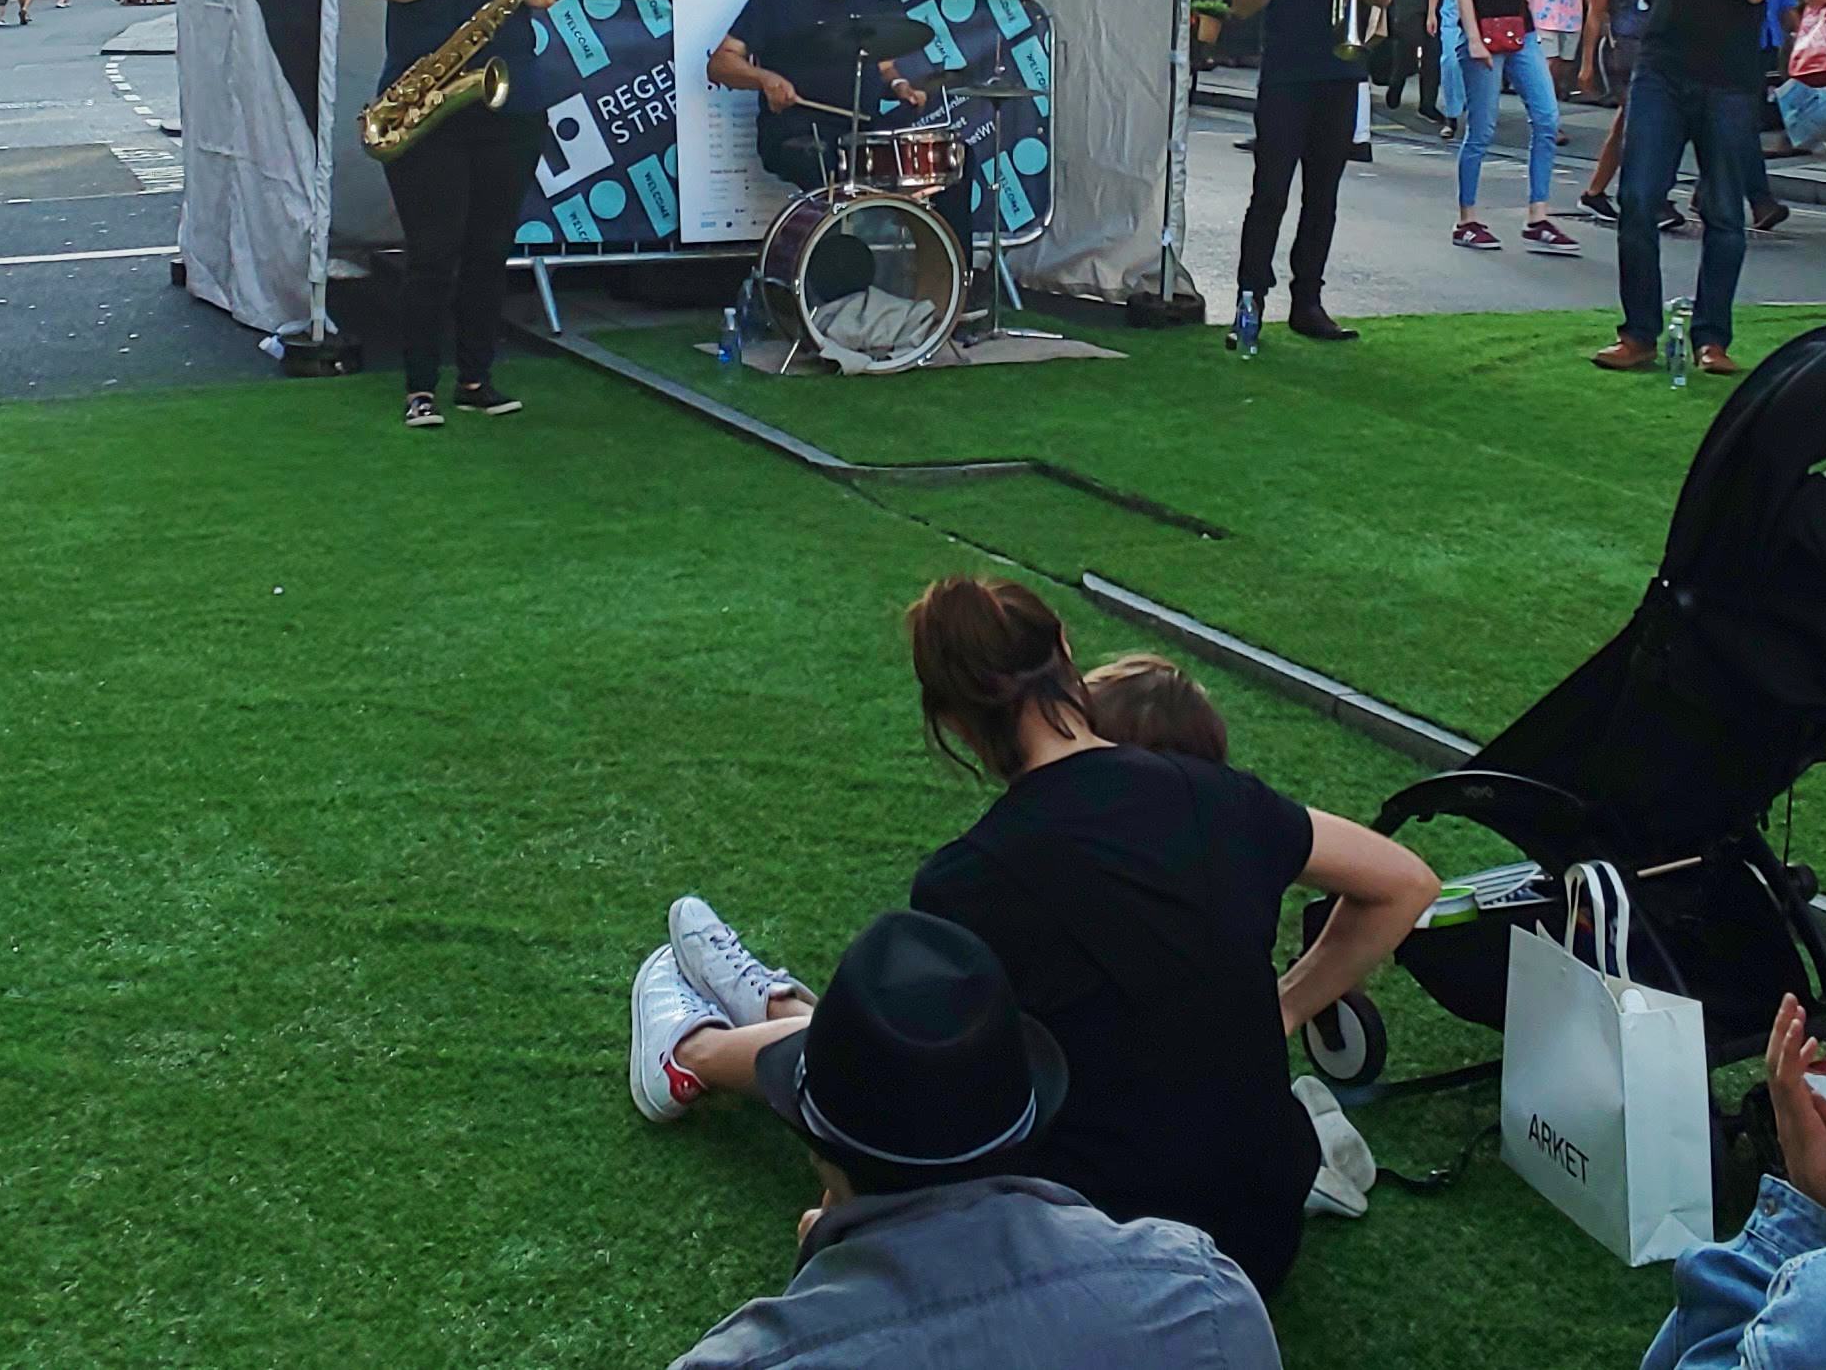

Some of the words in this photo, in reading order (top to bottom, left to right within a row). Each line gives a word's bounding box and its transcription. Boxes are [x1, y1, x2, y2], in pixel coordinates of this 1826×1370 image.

[564, 10, 594, 59] WELCOME
[644, 171, 671, 219] WELCOME
[1528, 1113, 1589, 1184] ARKET
